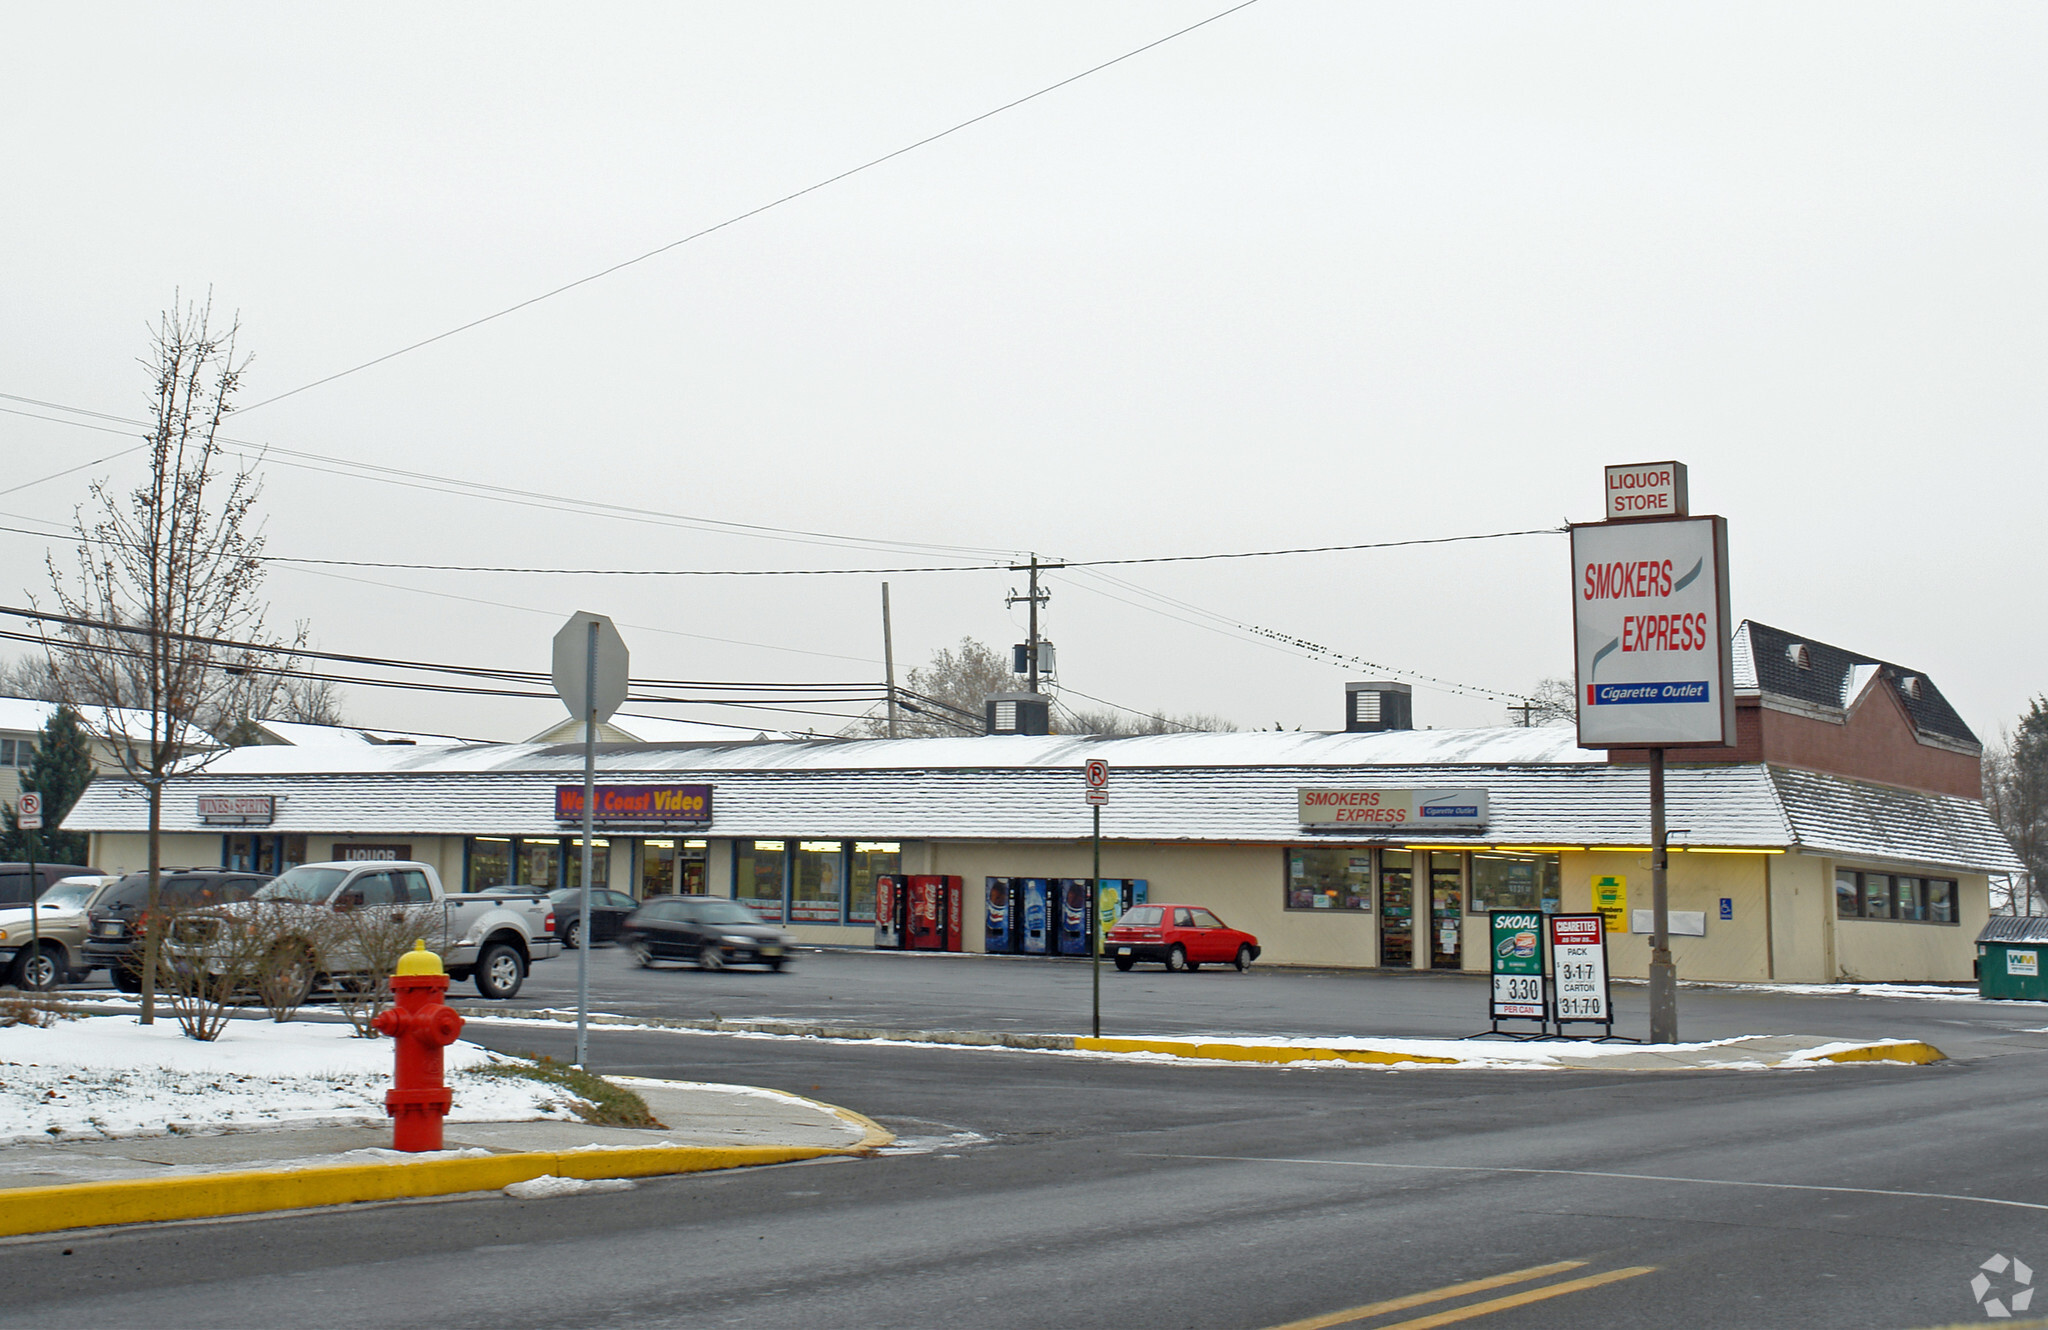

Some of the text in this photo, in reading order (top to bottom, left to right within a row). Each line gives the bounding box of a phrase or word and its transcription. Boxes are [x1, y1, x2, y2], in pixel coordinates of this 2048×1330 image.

[1609, 471, 1671, 490] LIQUOR
[1614, 493, 1668, 511] STORE
[1583, 559, 1673, 601] SMOKERS
[1621, 612, 1707, 652] EXPRESS
[1600, 685, 1703, 701] Cigarette Outlet
[198, 798, 229, 814] WINES
[235, 798, 270, 814] SPIRITS
[560, 790, 704, 811] Wet Coast Video
[1304, 792, 1381, 806] SMOKERS
[1335, 808, 1407, 822] EXPRESS
[1425, 807, 1477, 816] Cigarette Outlet
[1494, 915, 1539, 930] SKOAL
[1555, 921, 1597, 932] CIGARETTES
[1567, 947, 1588, 956] PACK
[2008, 954, 2036, 965] WM
[1563, 963, 1594, 980] 3.17
[1509, 978, 1539, 1000] 3.30
[1563, 984, 1596, 992] CARTON
[1503, 1005, 1535, 1014] PER CAN
[1562, 998, 1600, 1014] 31.70
